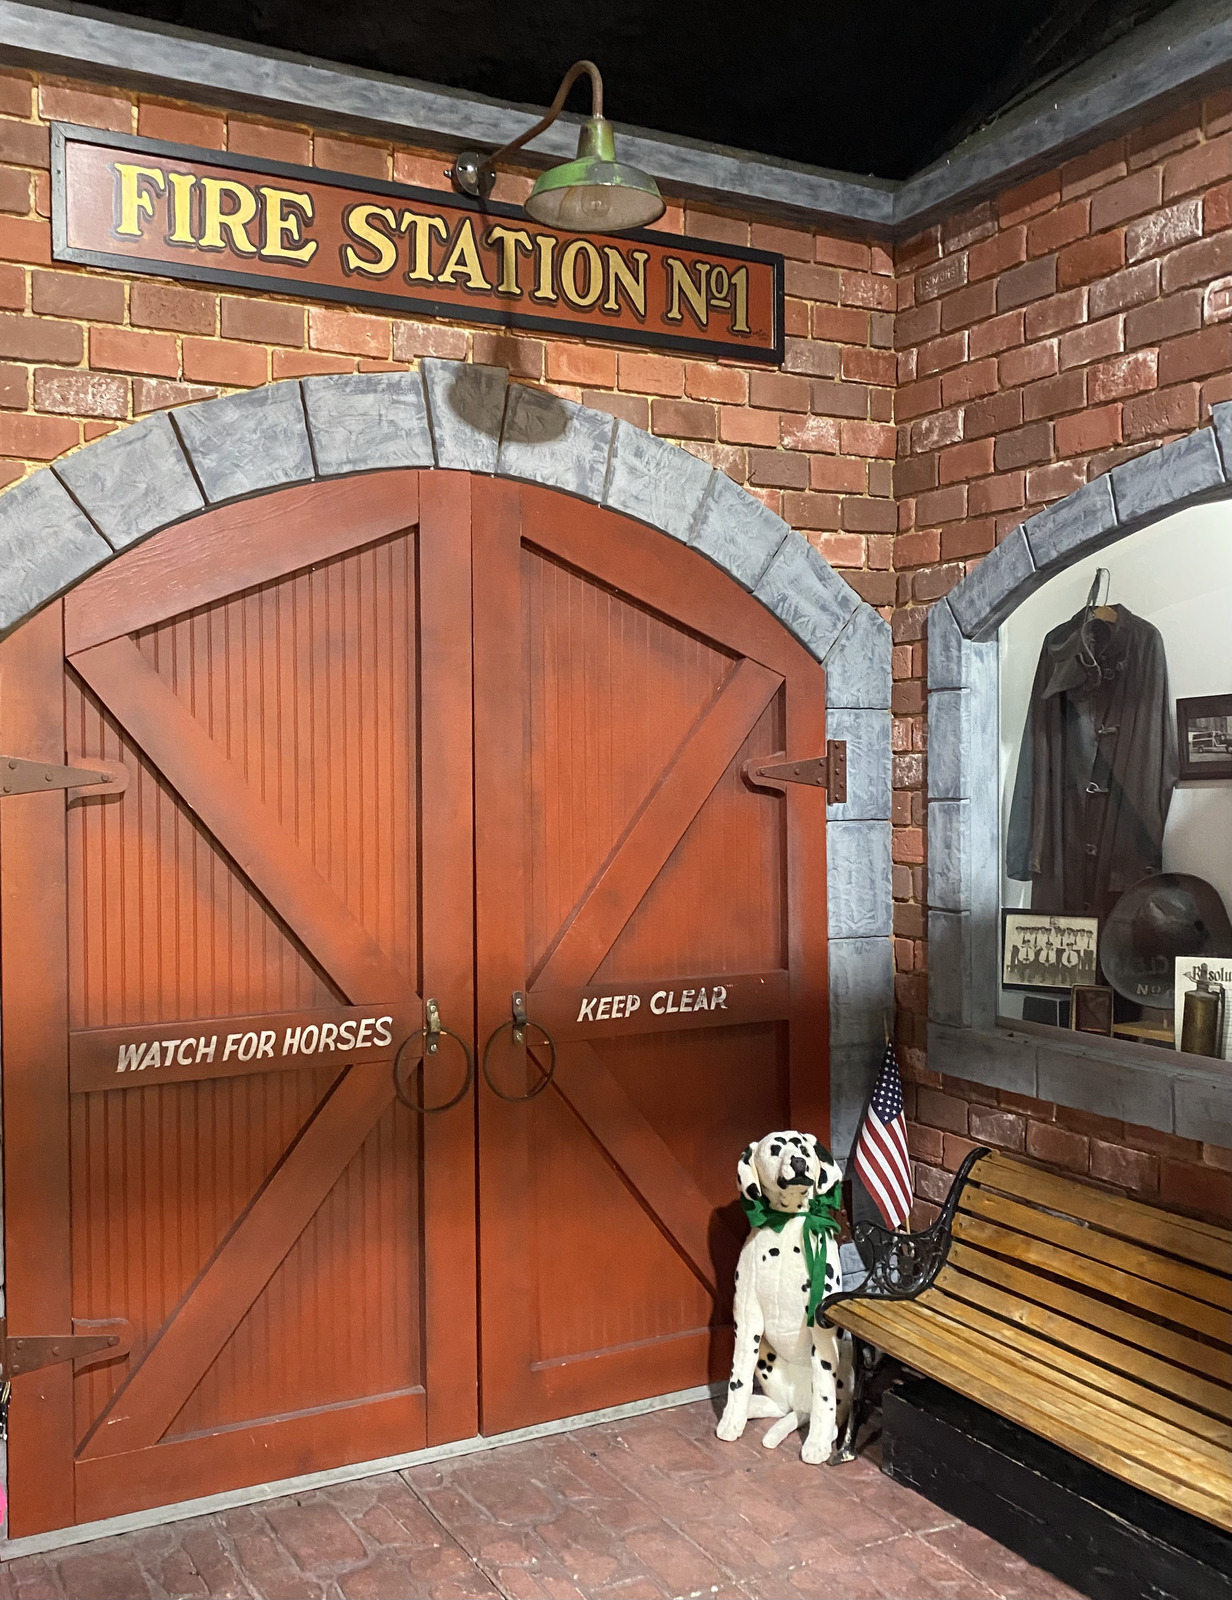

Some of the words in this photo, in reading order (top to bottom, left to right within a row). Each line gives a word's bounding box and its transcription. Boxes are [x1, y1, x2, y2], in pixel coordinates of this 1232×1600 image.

[112, 161, 319, 264] FIRE
[344, 203, 649, 318] STATION
[1192, 965, 1232, 982] Rsolu
[576, 994, 641, 1022] KEEP
[650, 985, 728, 1015] CLEAR
[115, 1035, 217, 1073] WATCH
[222, 1030, 276, 1062] FOR
[282, 1016, 393, 1056] HORSES
